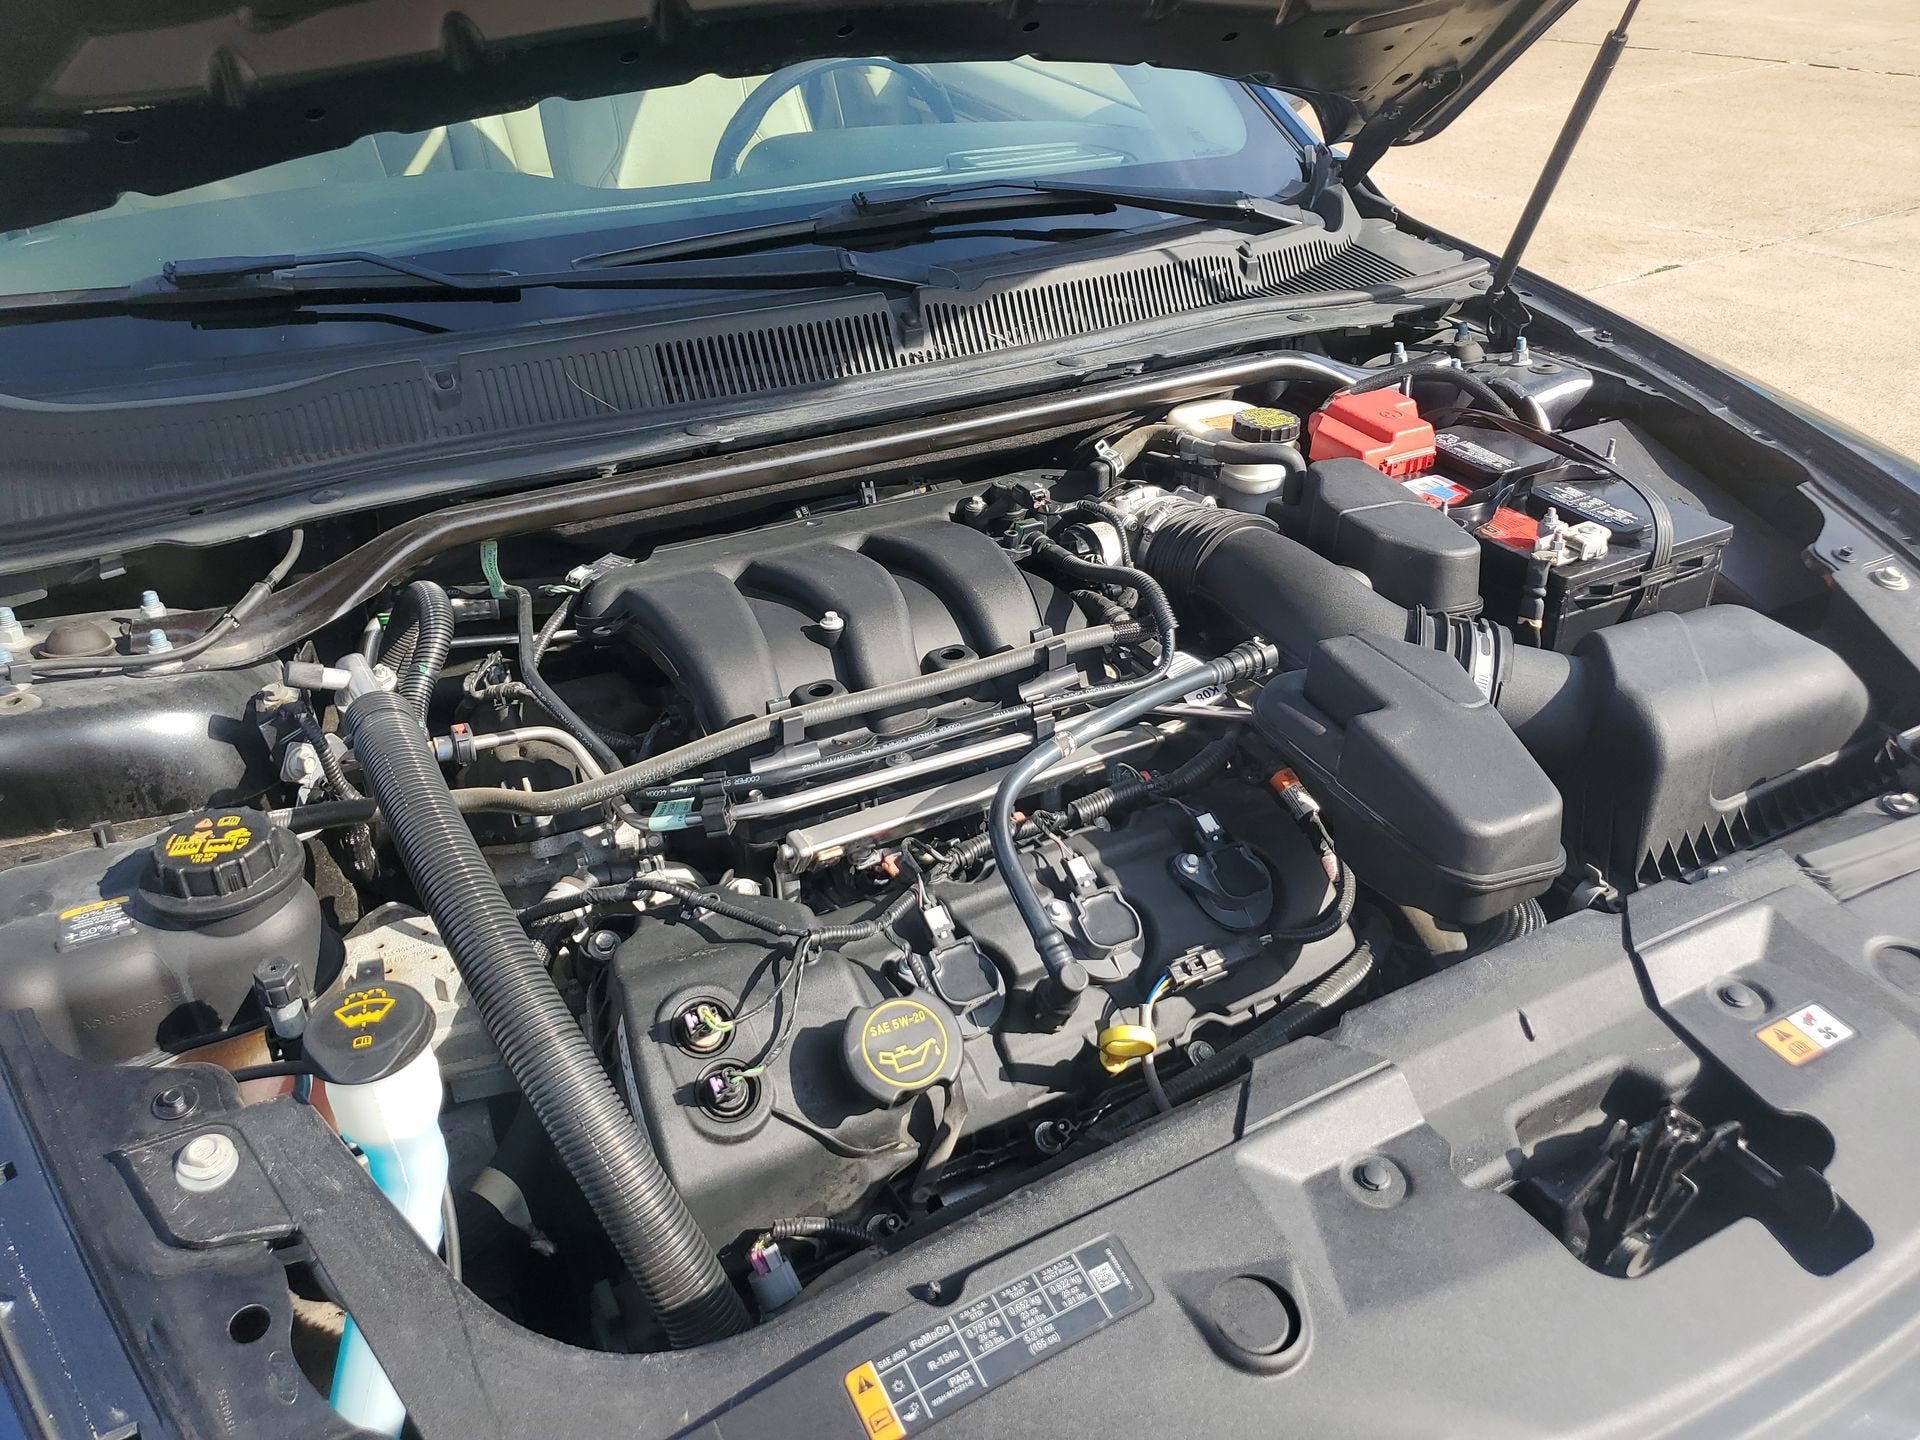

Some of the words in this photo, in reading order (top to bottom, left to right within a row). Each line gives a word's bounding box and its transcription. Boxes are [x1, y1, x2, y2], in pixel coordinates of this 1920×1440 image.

[1193, 685, 1221, 703] K08
[870, 1022, 891, 1037] SAE
[891, 1010, 926, 1029] 5W-20
[1069, 1273, 1082, 1287] kg
[1029, 1293, 1042, 1307] kg
[987, 1315, 1001, 1329] kg
[876, 1356, 893, 1369] SAE
[907, 1321, 951, 1351] FoMoCo
[948, 1370, 970, 1387] PAG
